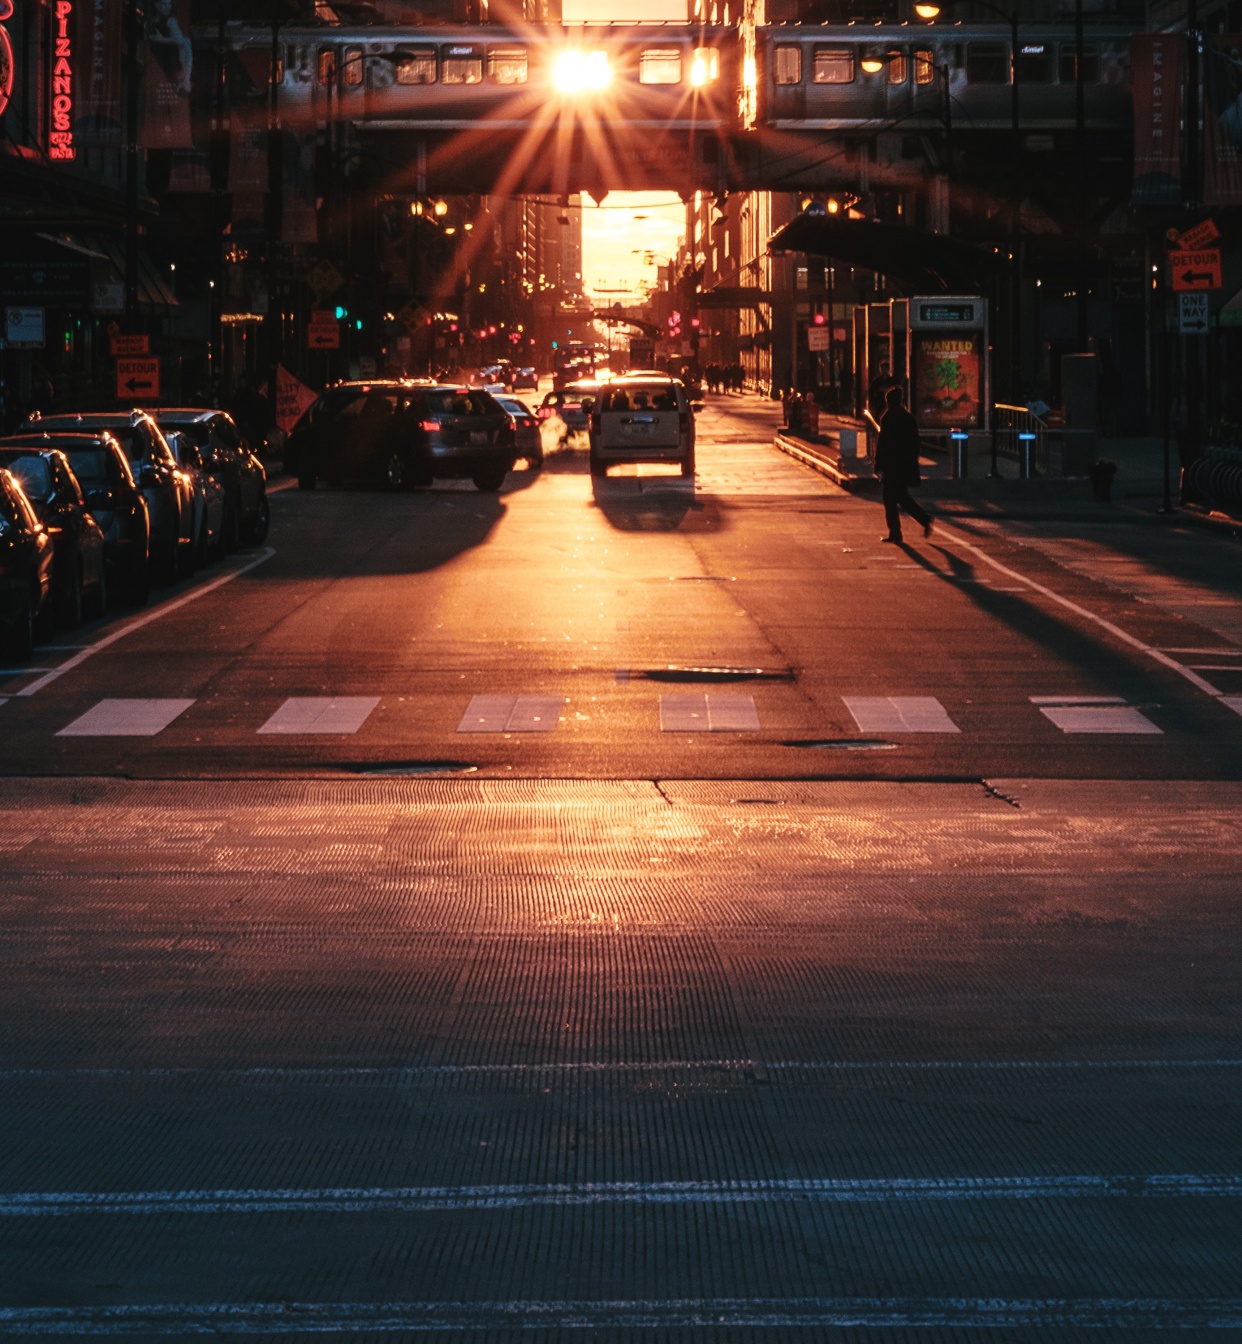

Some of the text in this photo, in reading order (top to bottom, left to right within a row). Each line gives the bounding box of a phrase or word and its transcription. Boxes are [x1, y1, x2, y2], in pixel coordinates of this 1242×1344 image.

[53, 0, 73, 131] PIZANOS
[1152, 42, 1163, 137] IMAGINE
[1173, 254, 1218, 266] DETOUR
[1181, 295, 1206, 306] ONE
[1182, 307, 1207, 317] WAY
[921, 340, 973, 352] WANTED
[119, 363, 157, 374] DETOUR
[278, 396, 299, 406] ORK
